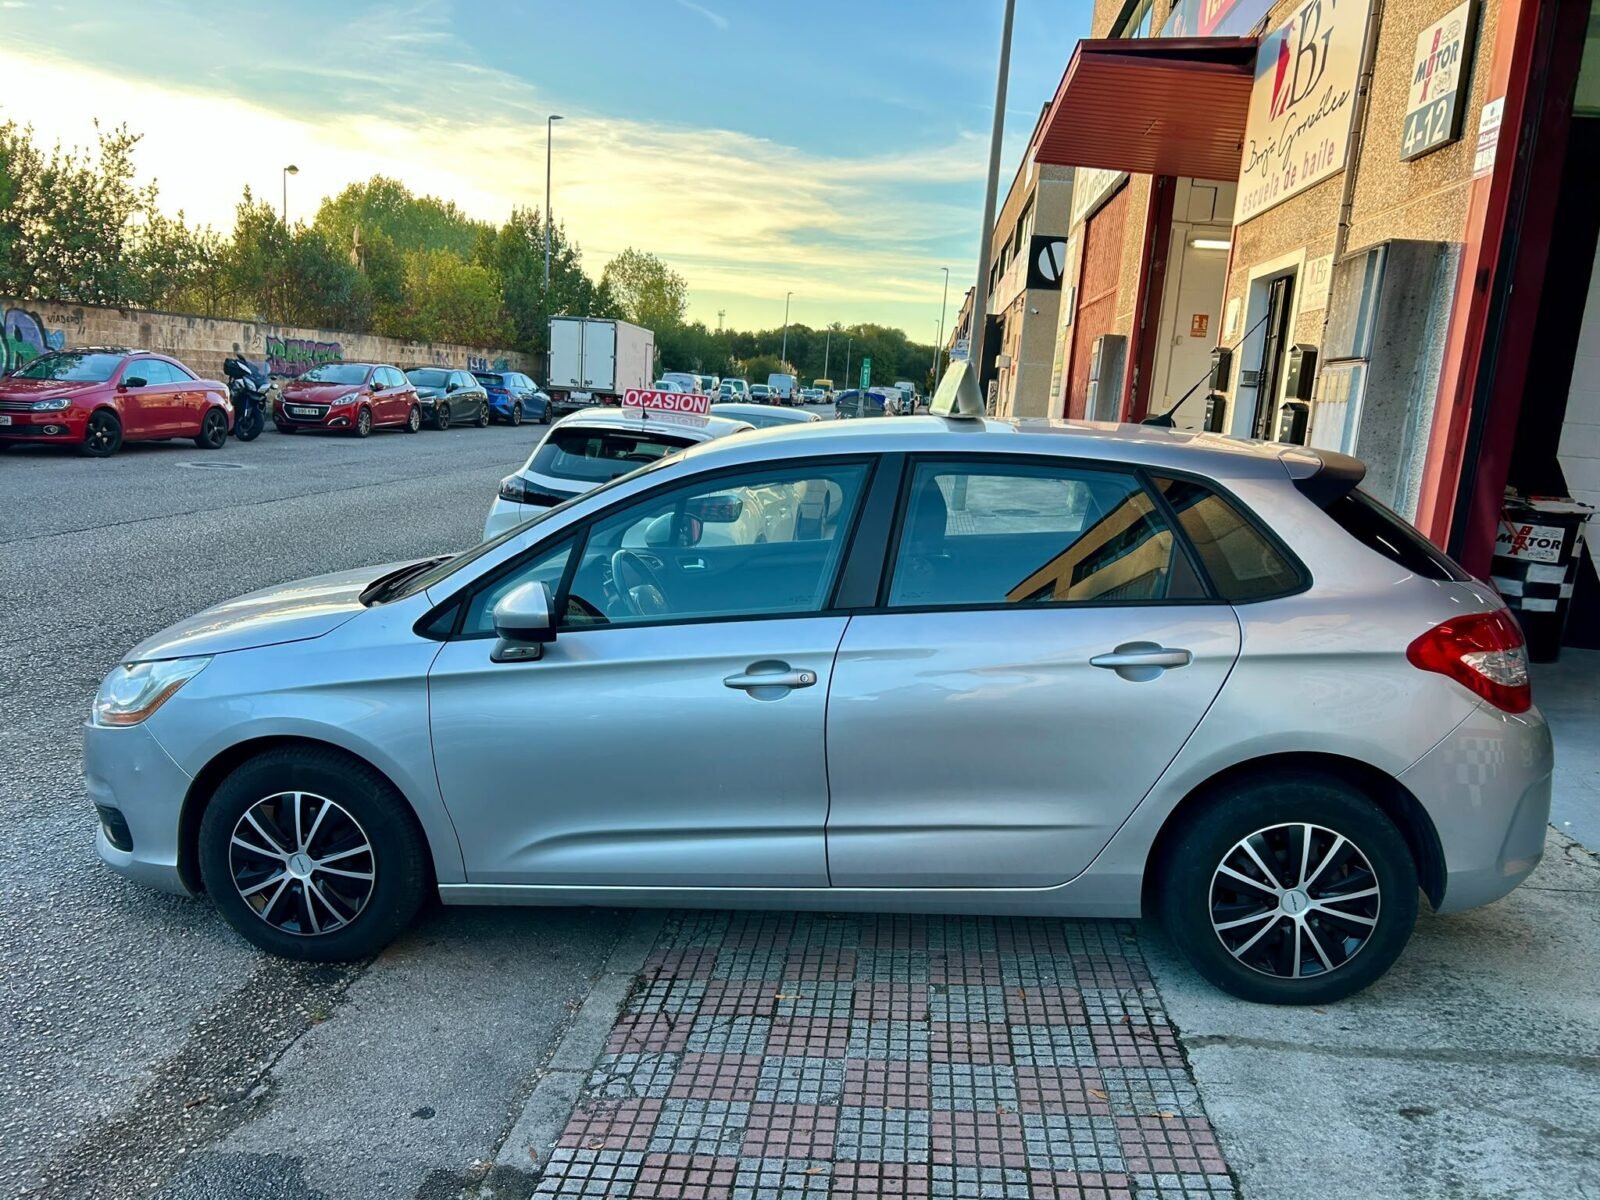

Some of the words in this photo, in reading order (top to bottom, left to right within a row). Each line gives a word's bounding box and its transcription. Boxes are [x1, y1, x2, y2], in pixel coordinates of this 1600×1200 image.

[1413, 39, 1460, 86] MOTOR
[1403, 99, 1448, 154] 4-12
[1242, 172, 1279, 215] escuela
[1283, 161, 1297, 191] de
[1302, 138, 1335, 180] baile
[625, 390, 707, 413] OCASION
